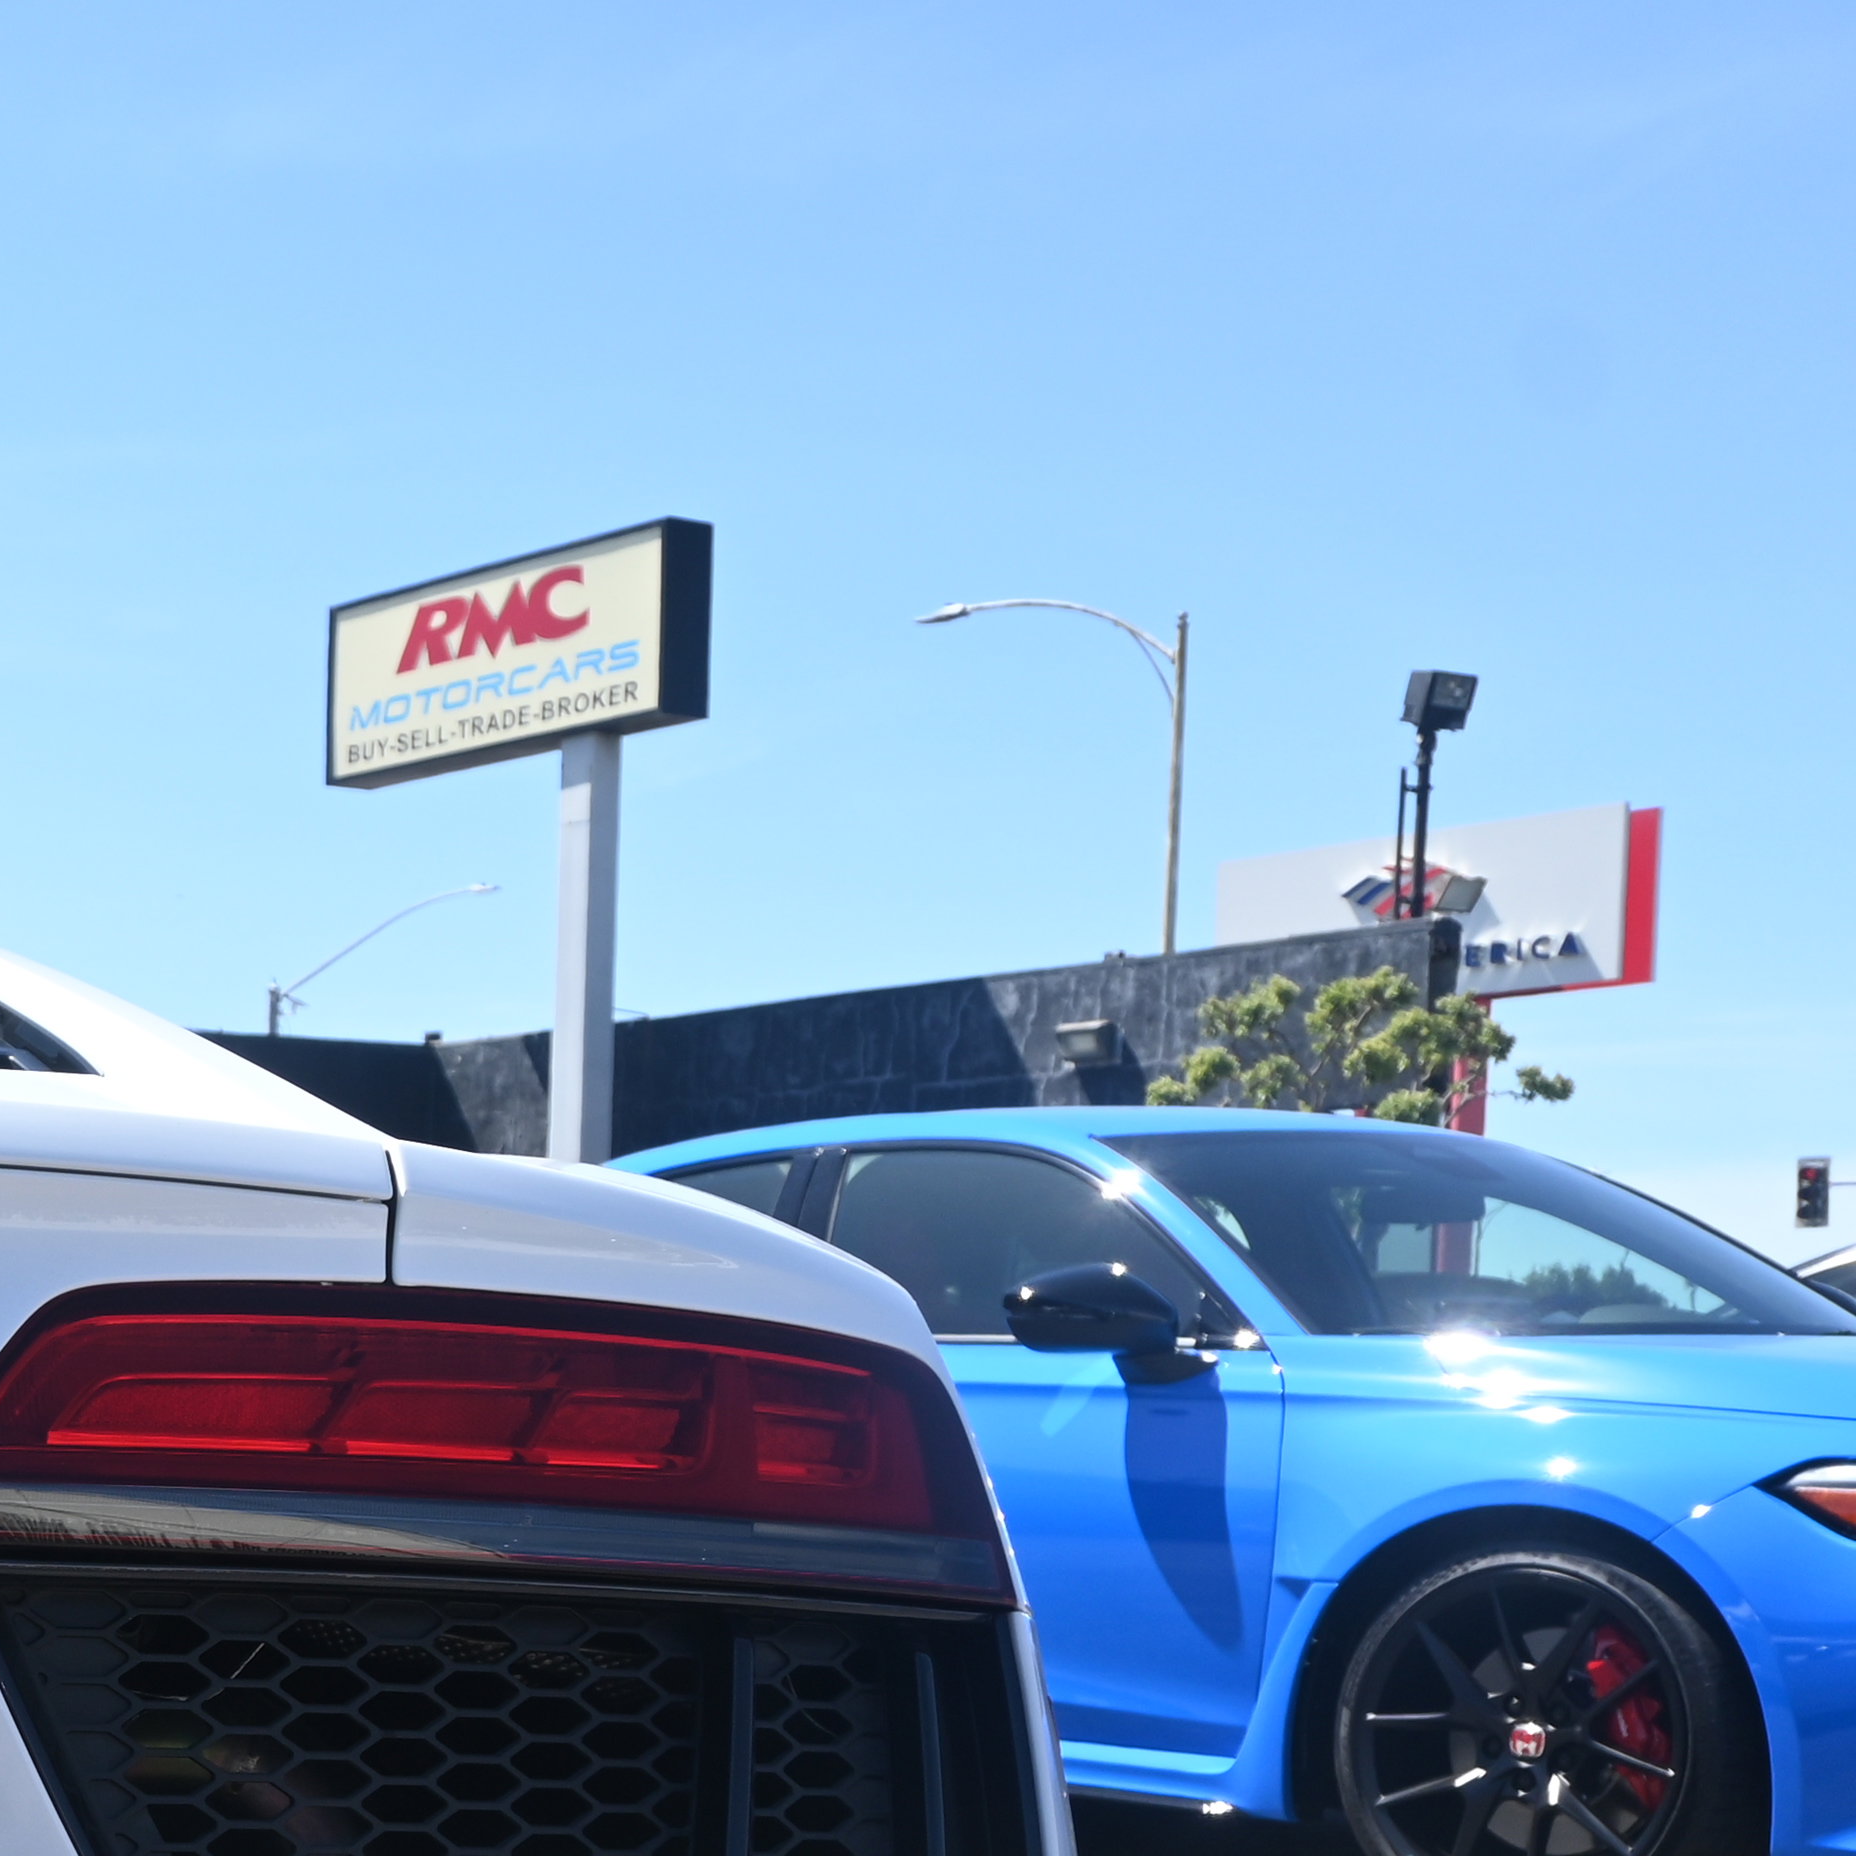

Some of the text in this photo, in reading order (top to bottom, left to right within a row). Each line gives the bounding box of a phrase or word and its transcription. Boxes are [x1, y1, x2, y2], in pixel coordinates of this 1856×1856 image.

[395, 564, 591, 675] RMC
[347, 681, 639, 764] BUY-SELL-TRADE-BROKER
[349, 638, 641, 732] MOTORCARS
